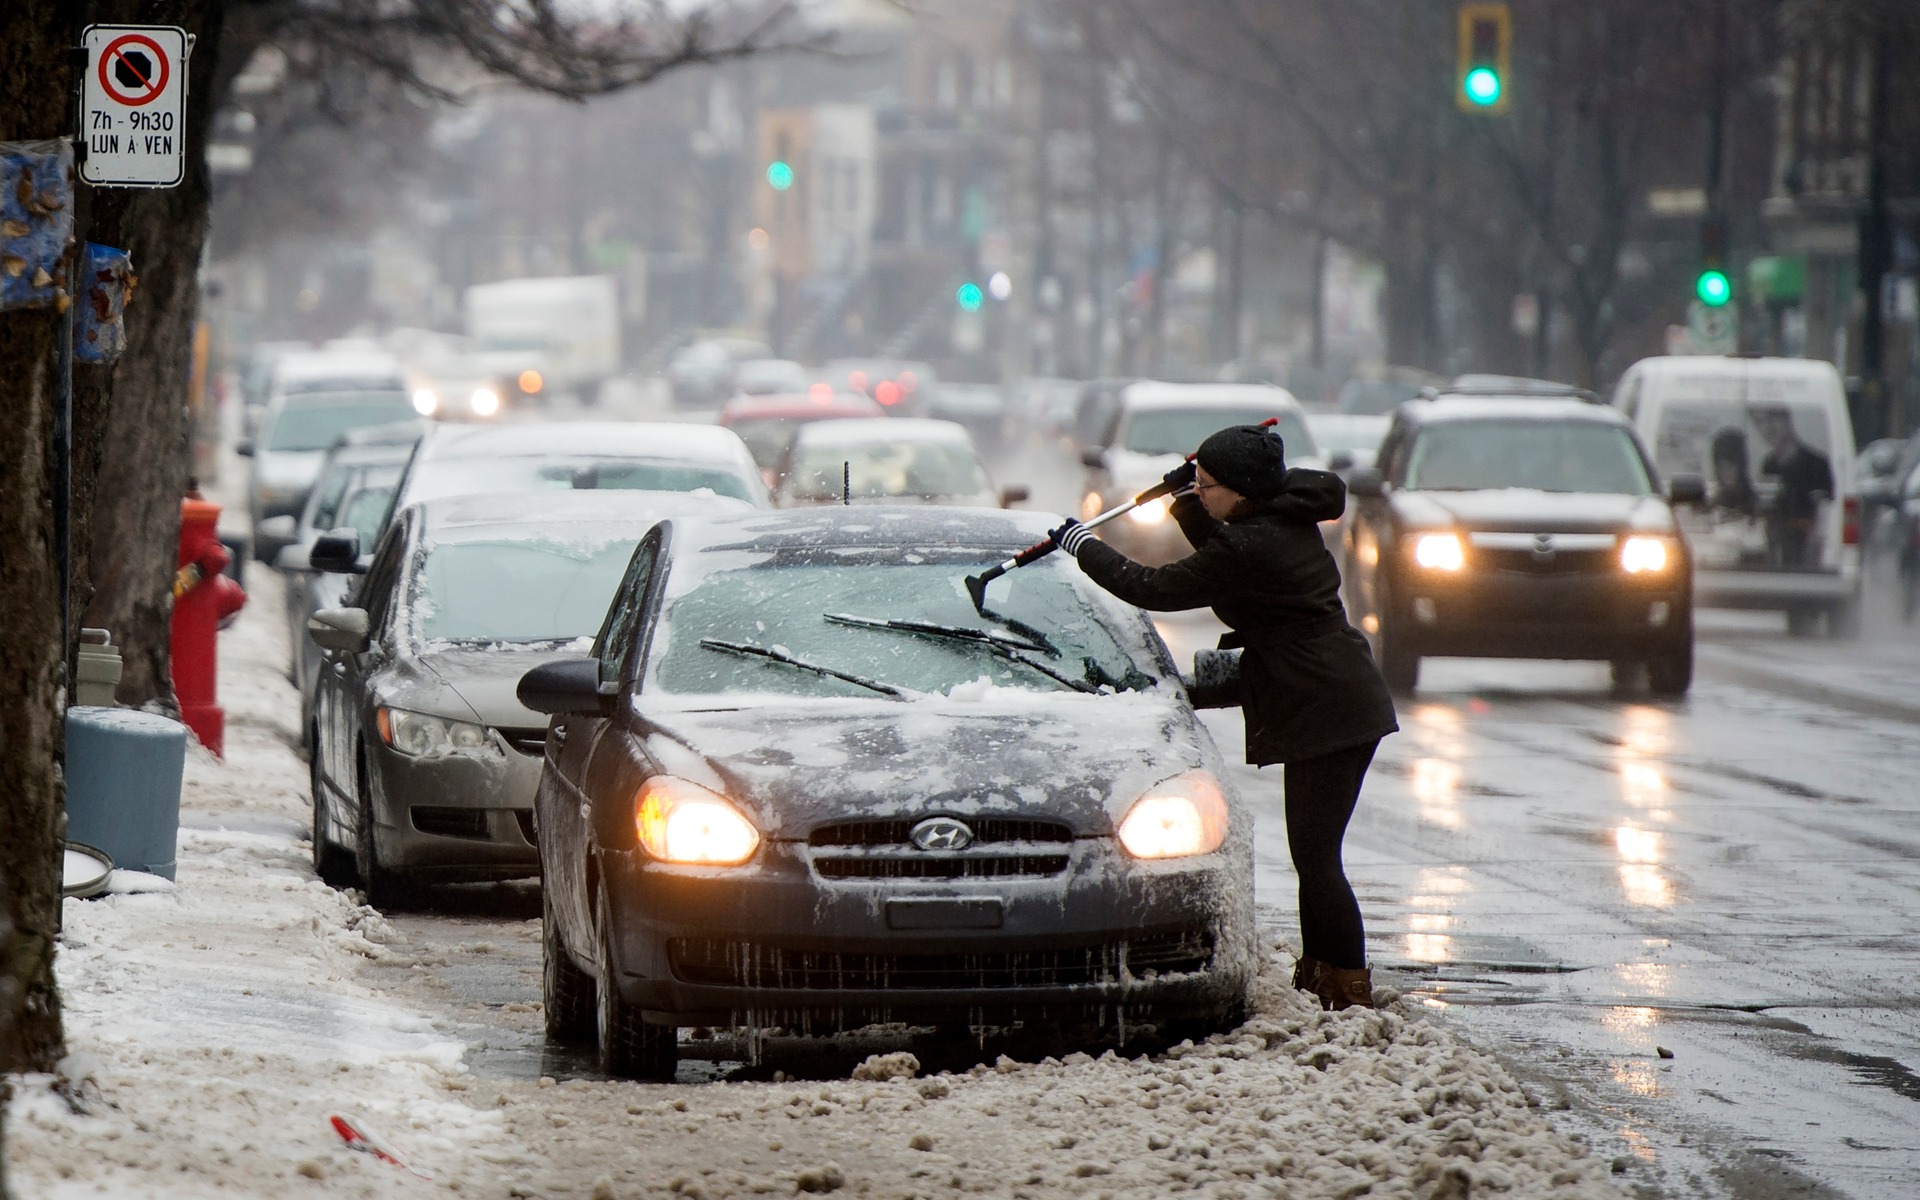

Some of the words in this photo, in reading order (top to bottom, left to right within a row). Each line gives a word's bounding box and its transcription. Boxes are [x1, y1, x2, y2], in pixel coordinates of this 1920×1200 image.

[91, 110, 112, 130] 7h
[129, 110, 174, 132] 9h30
[92, 134, 119, 154] LUN
[144, 135, 172, 155] VEN
